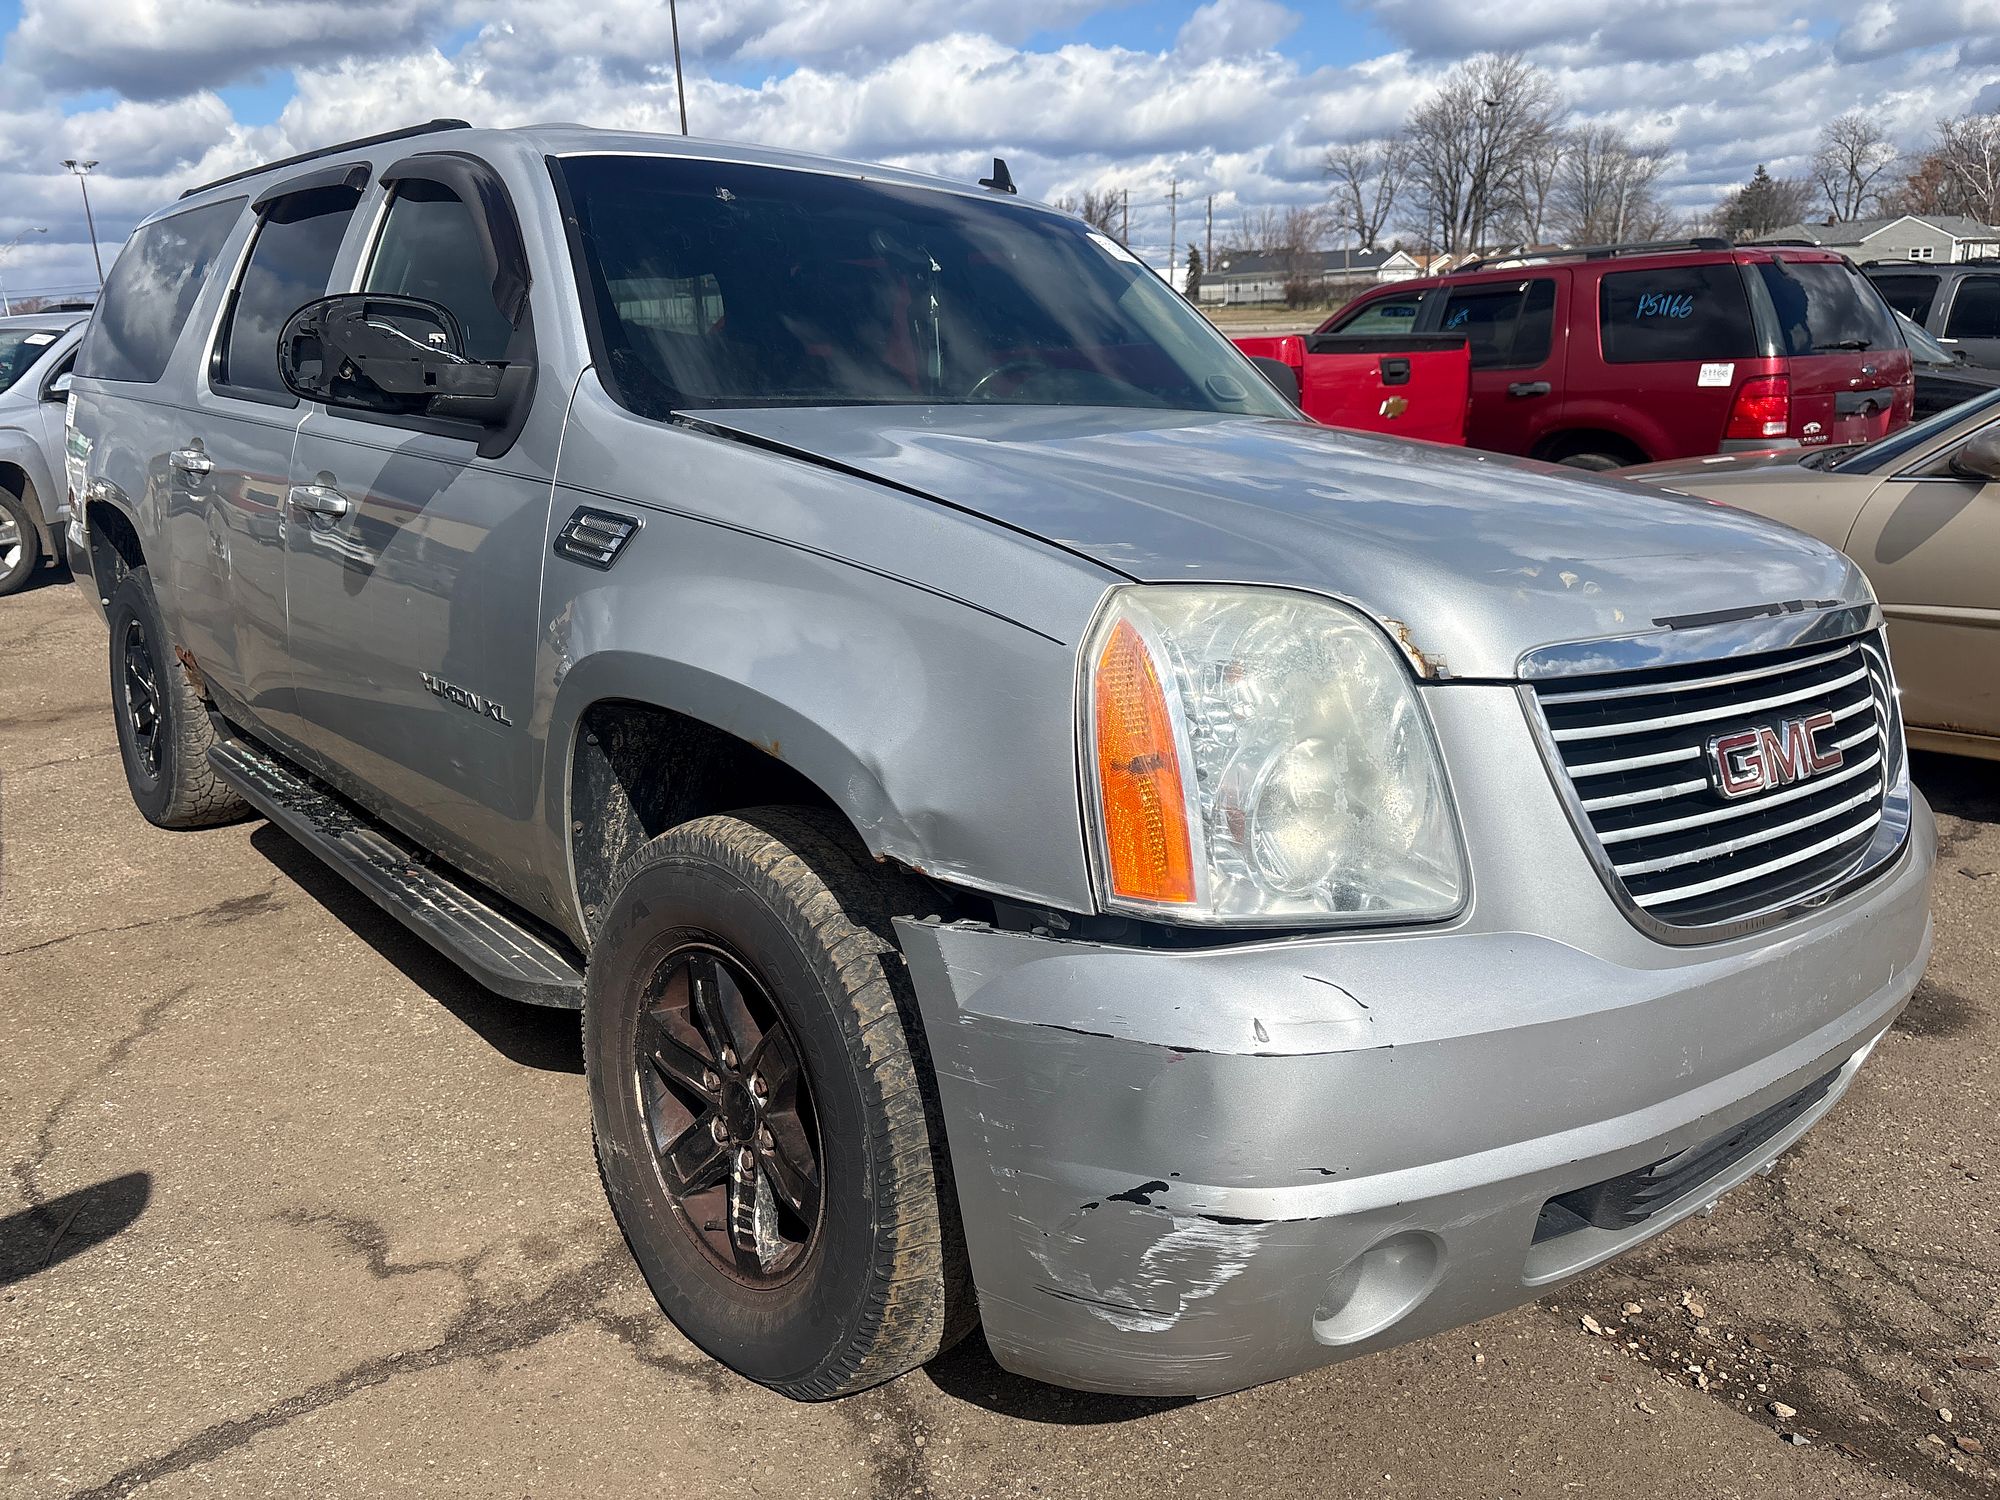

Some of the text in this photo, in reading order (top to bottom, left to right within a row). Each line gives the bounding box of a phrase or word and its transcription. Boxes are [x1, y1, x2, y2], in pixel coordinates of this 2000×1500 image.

[1636, 292, 1694, 319] P51166
[419, 669, 512, 727] YUKON XL
[1706, 711, 1844, 800] GMC
